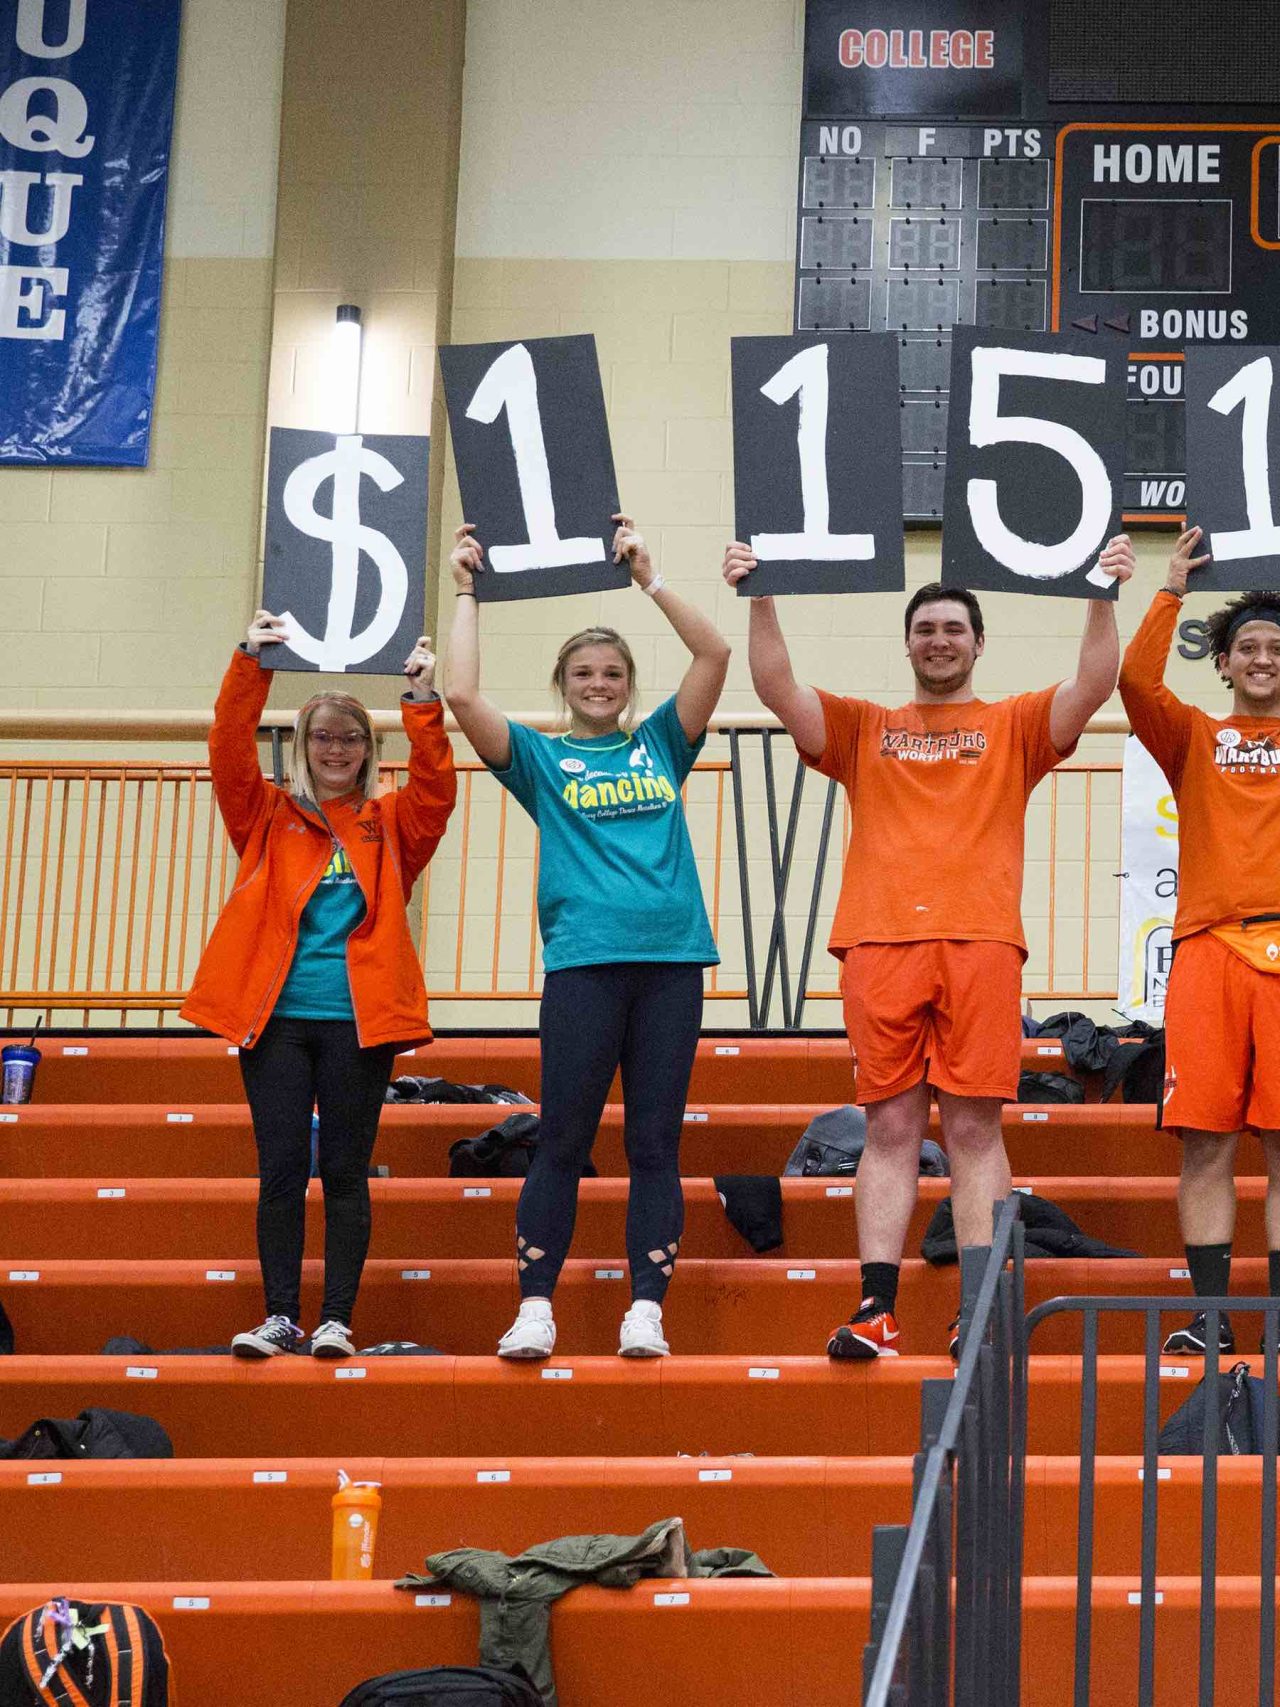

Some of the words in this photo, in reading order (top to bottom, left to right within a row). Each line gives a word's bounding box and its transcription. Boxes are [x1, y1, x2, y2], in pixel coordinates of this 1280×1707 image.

[838, 28, 995, 69] COLLEGE
[819, 126, 862, 155] NO
[918, 127, 937, 156] F
[982, 128, 1041, 157] PTS
[1093, 144, 1221, 184] HOME
[1140, 309, 1249, 339] BONUS
[281, 435, 409, 672] $
[465, 343, 606, 573] 1
[751, 343, 876, 561] 1
[897, 749, 943, 762] WORTH
[945, 748, 960, 760] IT
